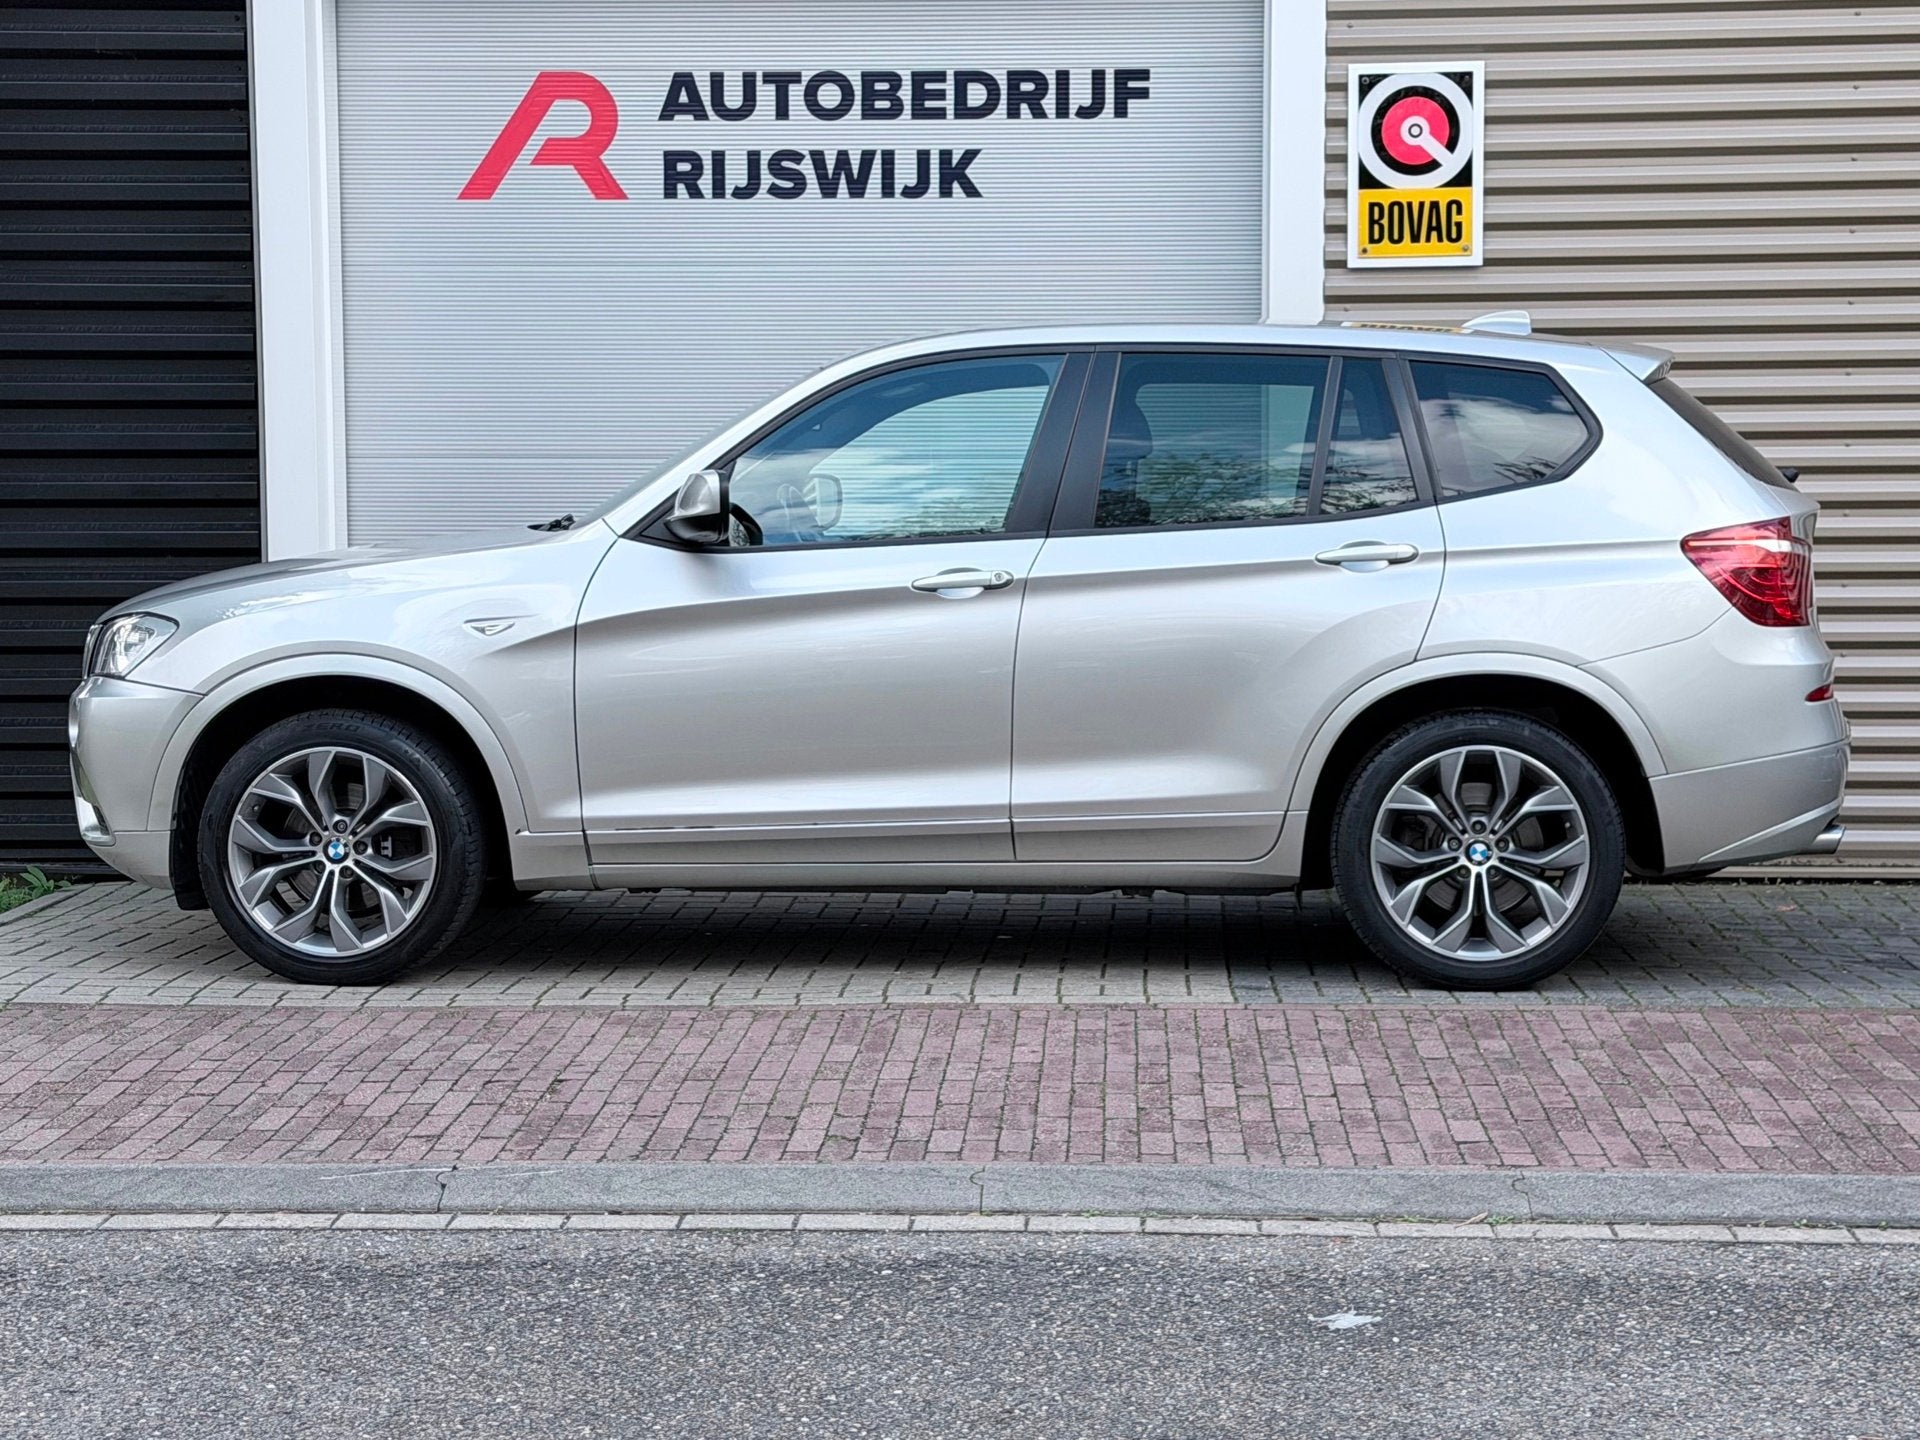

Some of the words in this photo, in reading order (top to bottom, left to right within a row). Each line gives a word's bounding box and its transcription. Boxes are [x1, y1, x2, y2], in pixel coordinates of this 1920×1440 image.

[658, 69, 1151, 121] AUTOBEDRIJF
[663, 149, 983, 199] RIJSWIJK
[1367, 199, 1463, 245] BOVAG
